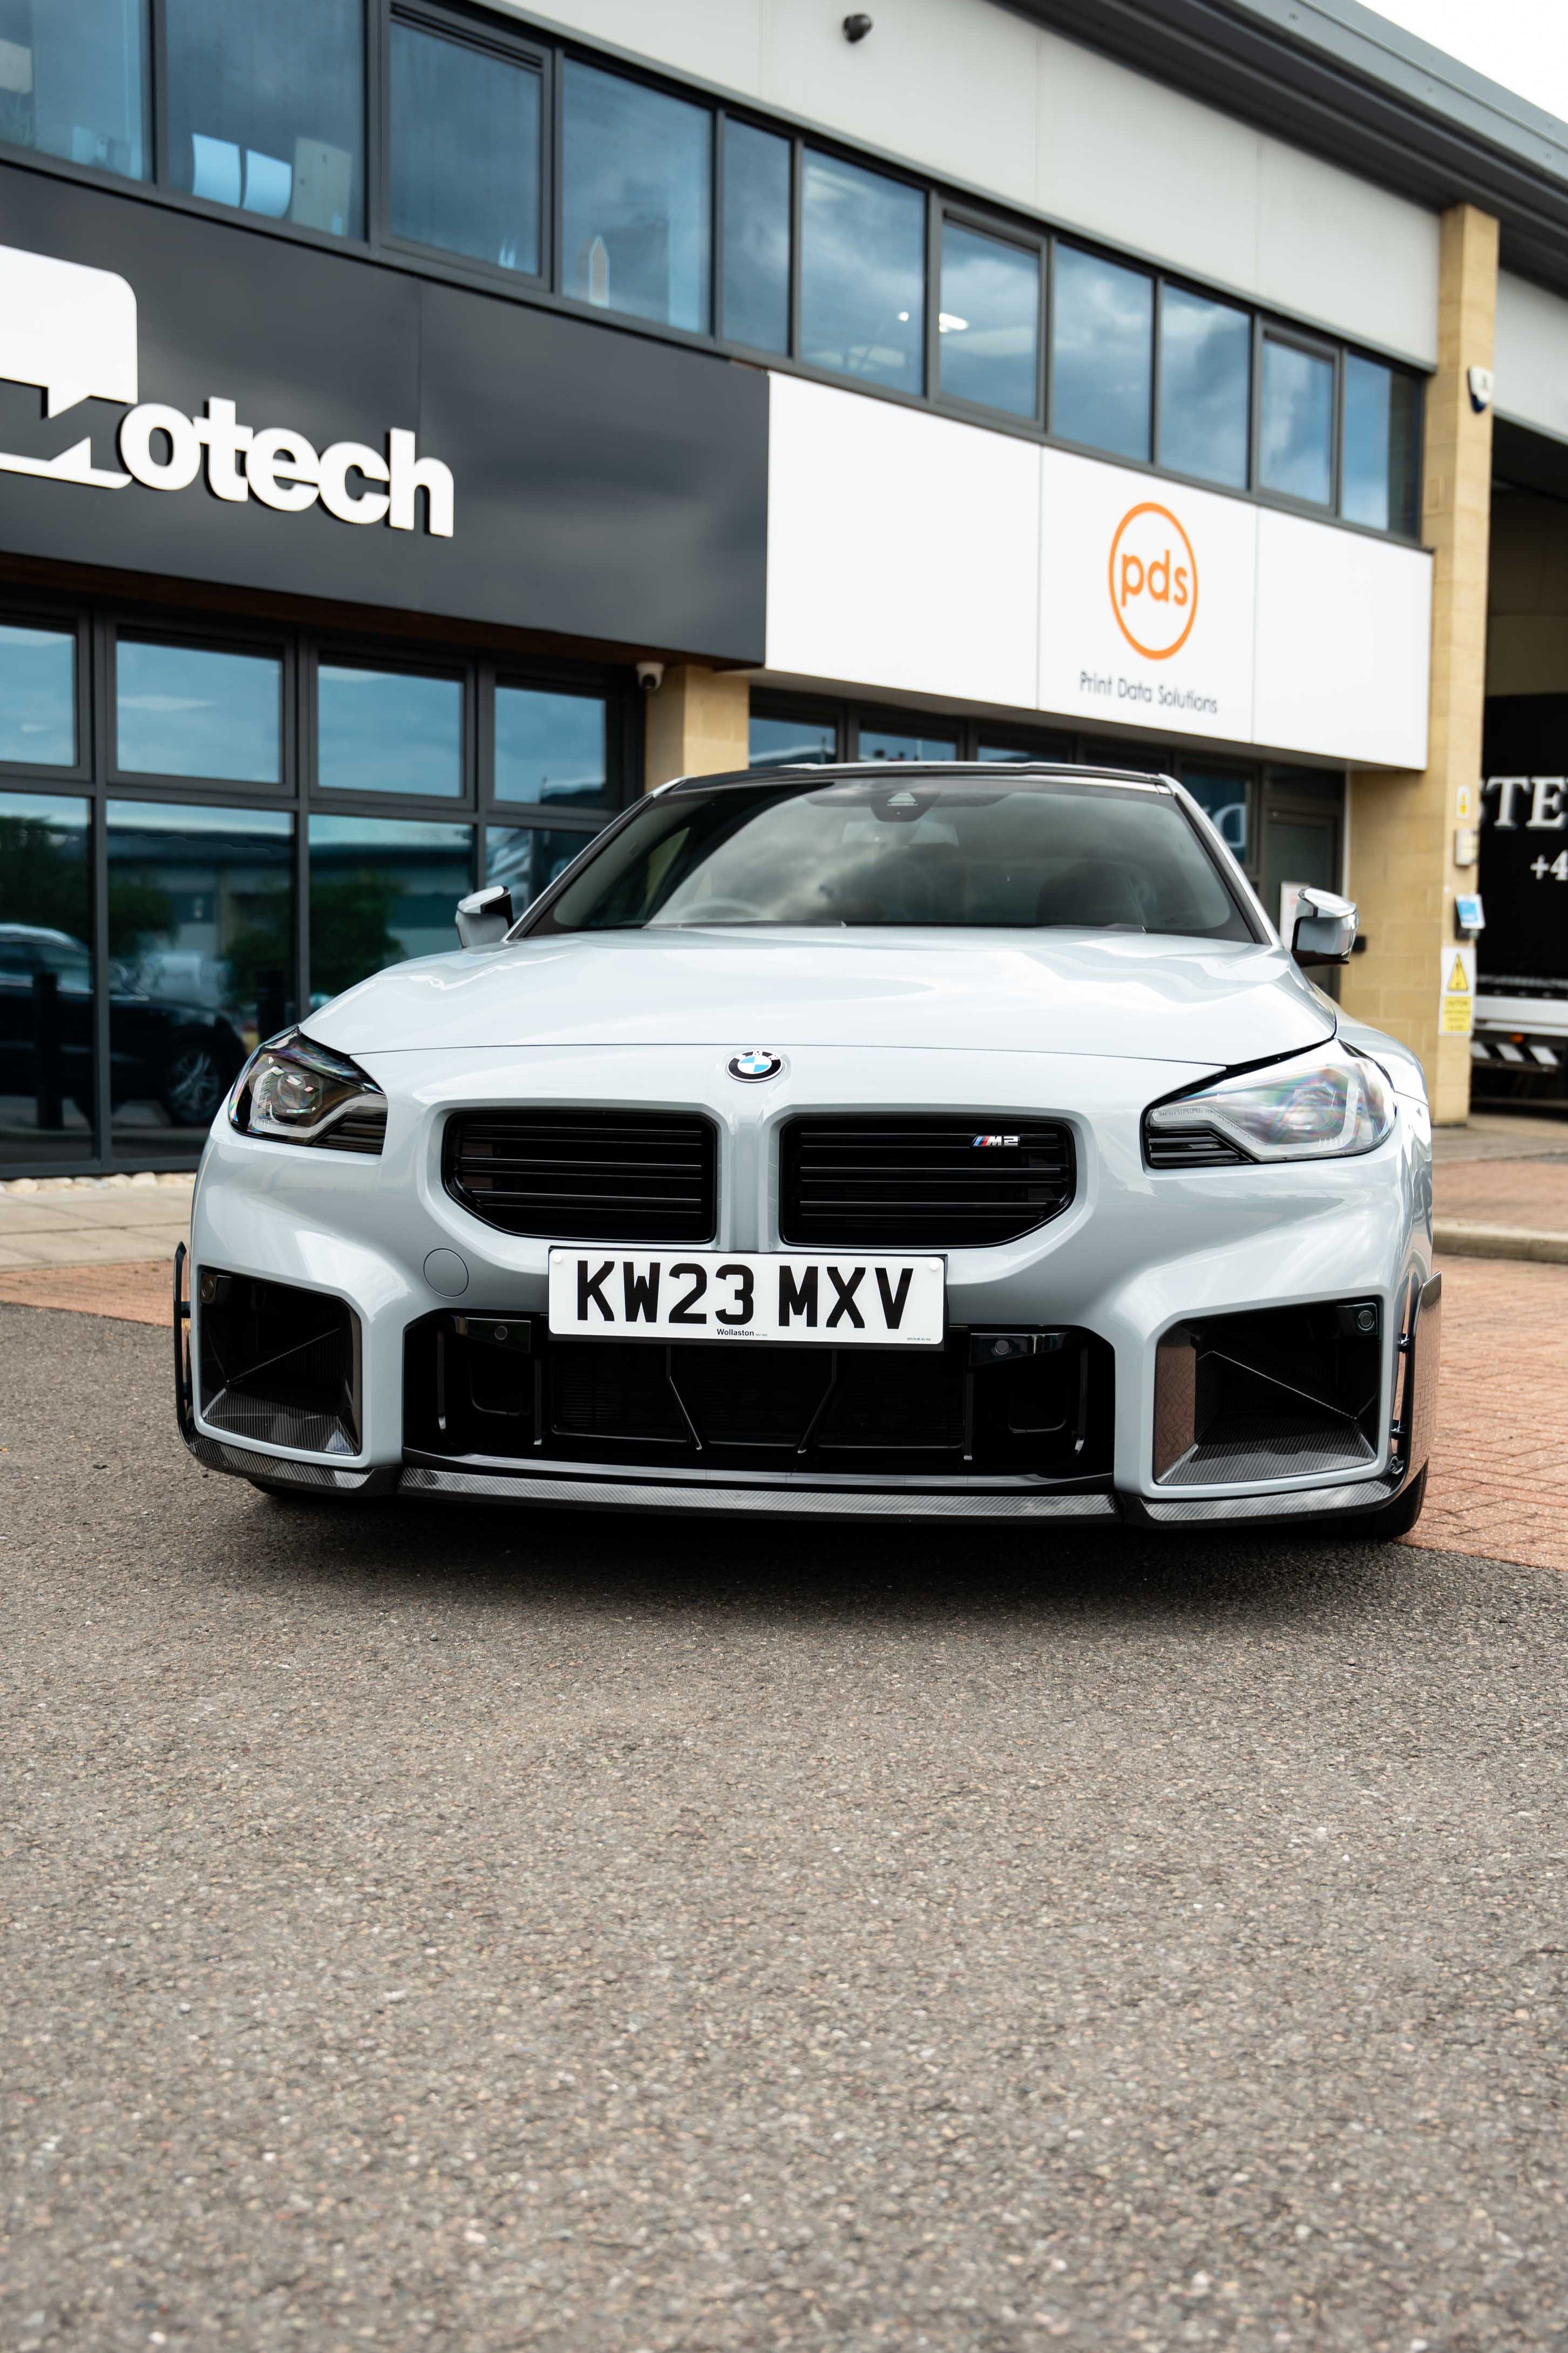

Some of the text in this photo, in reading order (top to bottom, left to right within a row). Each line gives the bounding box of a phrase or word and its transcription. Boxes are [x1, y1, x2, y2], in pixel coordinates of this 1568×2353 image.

[1121, 549, 1188, 608] pds
[1080, 671, 1218, 714] Print Data Solutions
[986, 1135, 1019, 1146] M2
[577, 1260, 914, 1330] KW23 MXV
[716, 1328, 755, 1336] Wollaston
